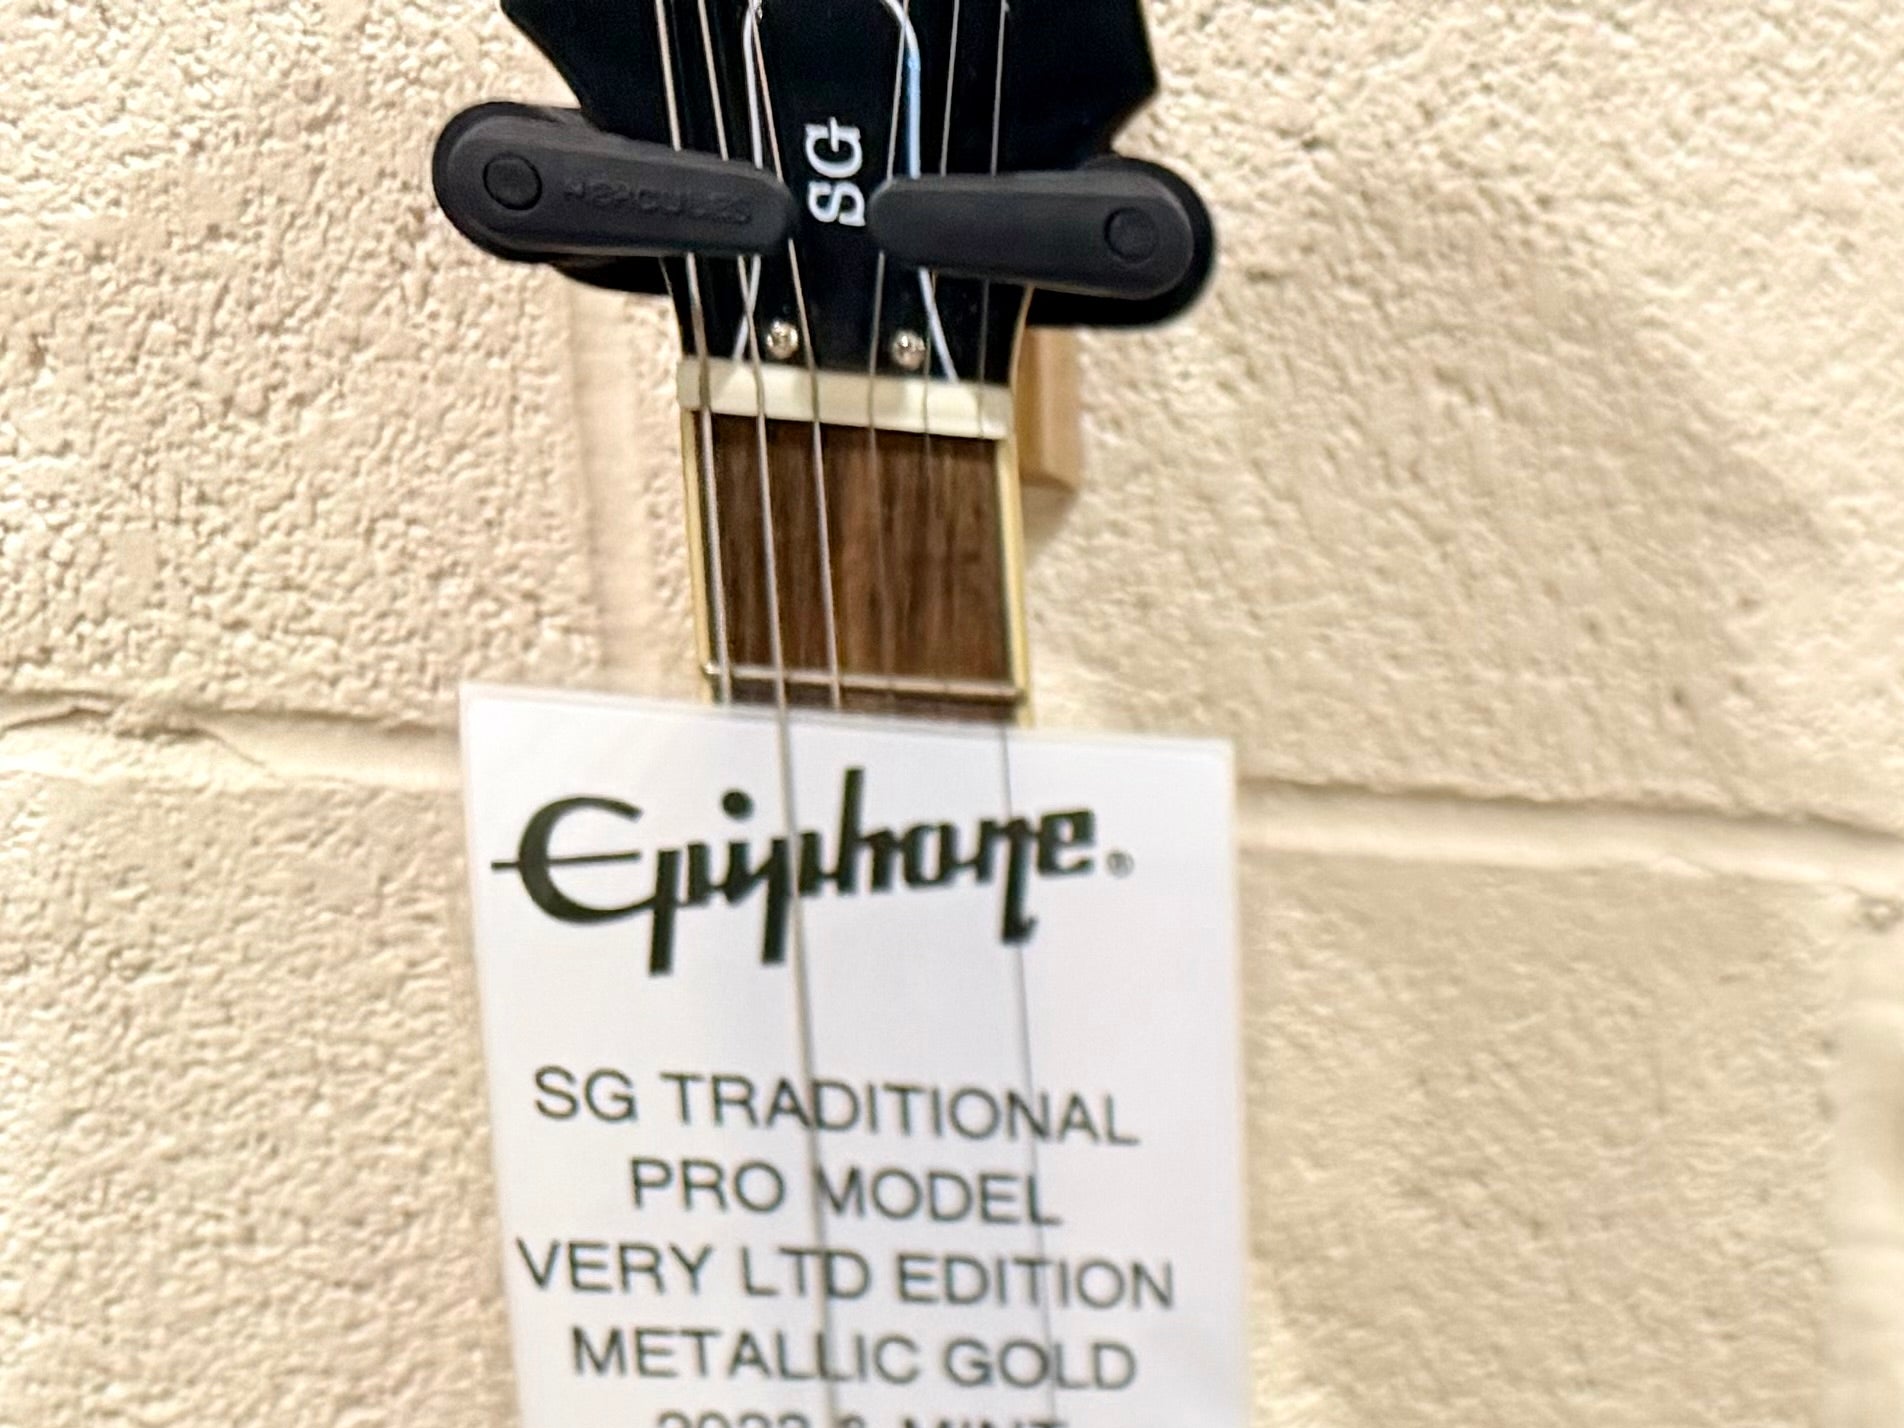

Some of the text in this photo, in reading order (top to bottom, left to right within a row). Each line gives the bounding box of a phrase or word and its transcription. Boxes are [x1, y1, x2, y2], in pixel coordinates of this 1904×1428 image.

[805, 117, 866, 227] SG
[534, 1066, 1141, 1146] SG TRADITIONAL
[630, 1157, 1063, 1226] PRO MODEL
[515, 1239, 1175, 1311] VERY LTD EDITION
[572, 1327, 1137, 1391] METALLIC GOLD
